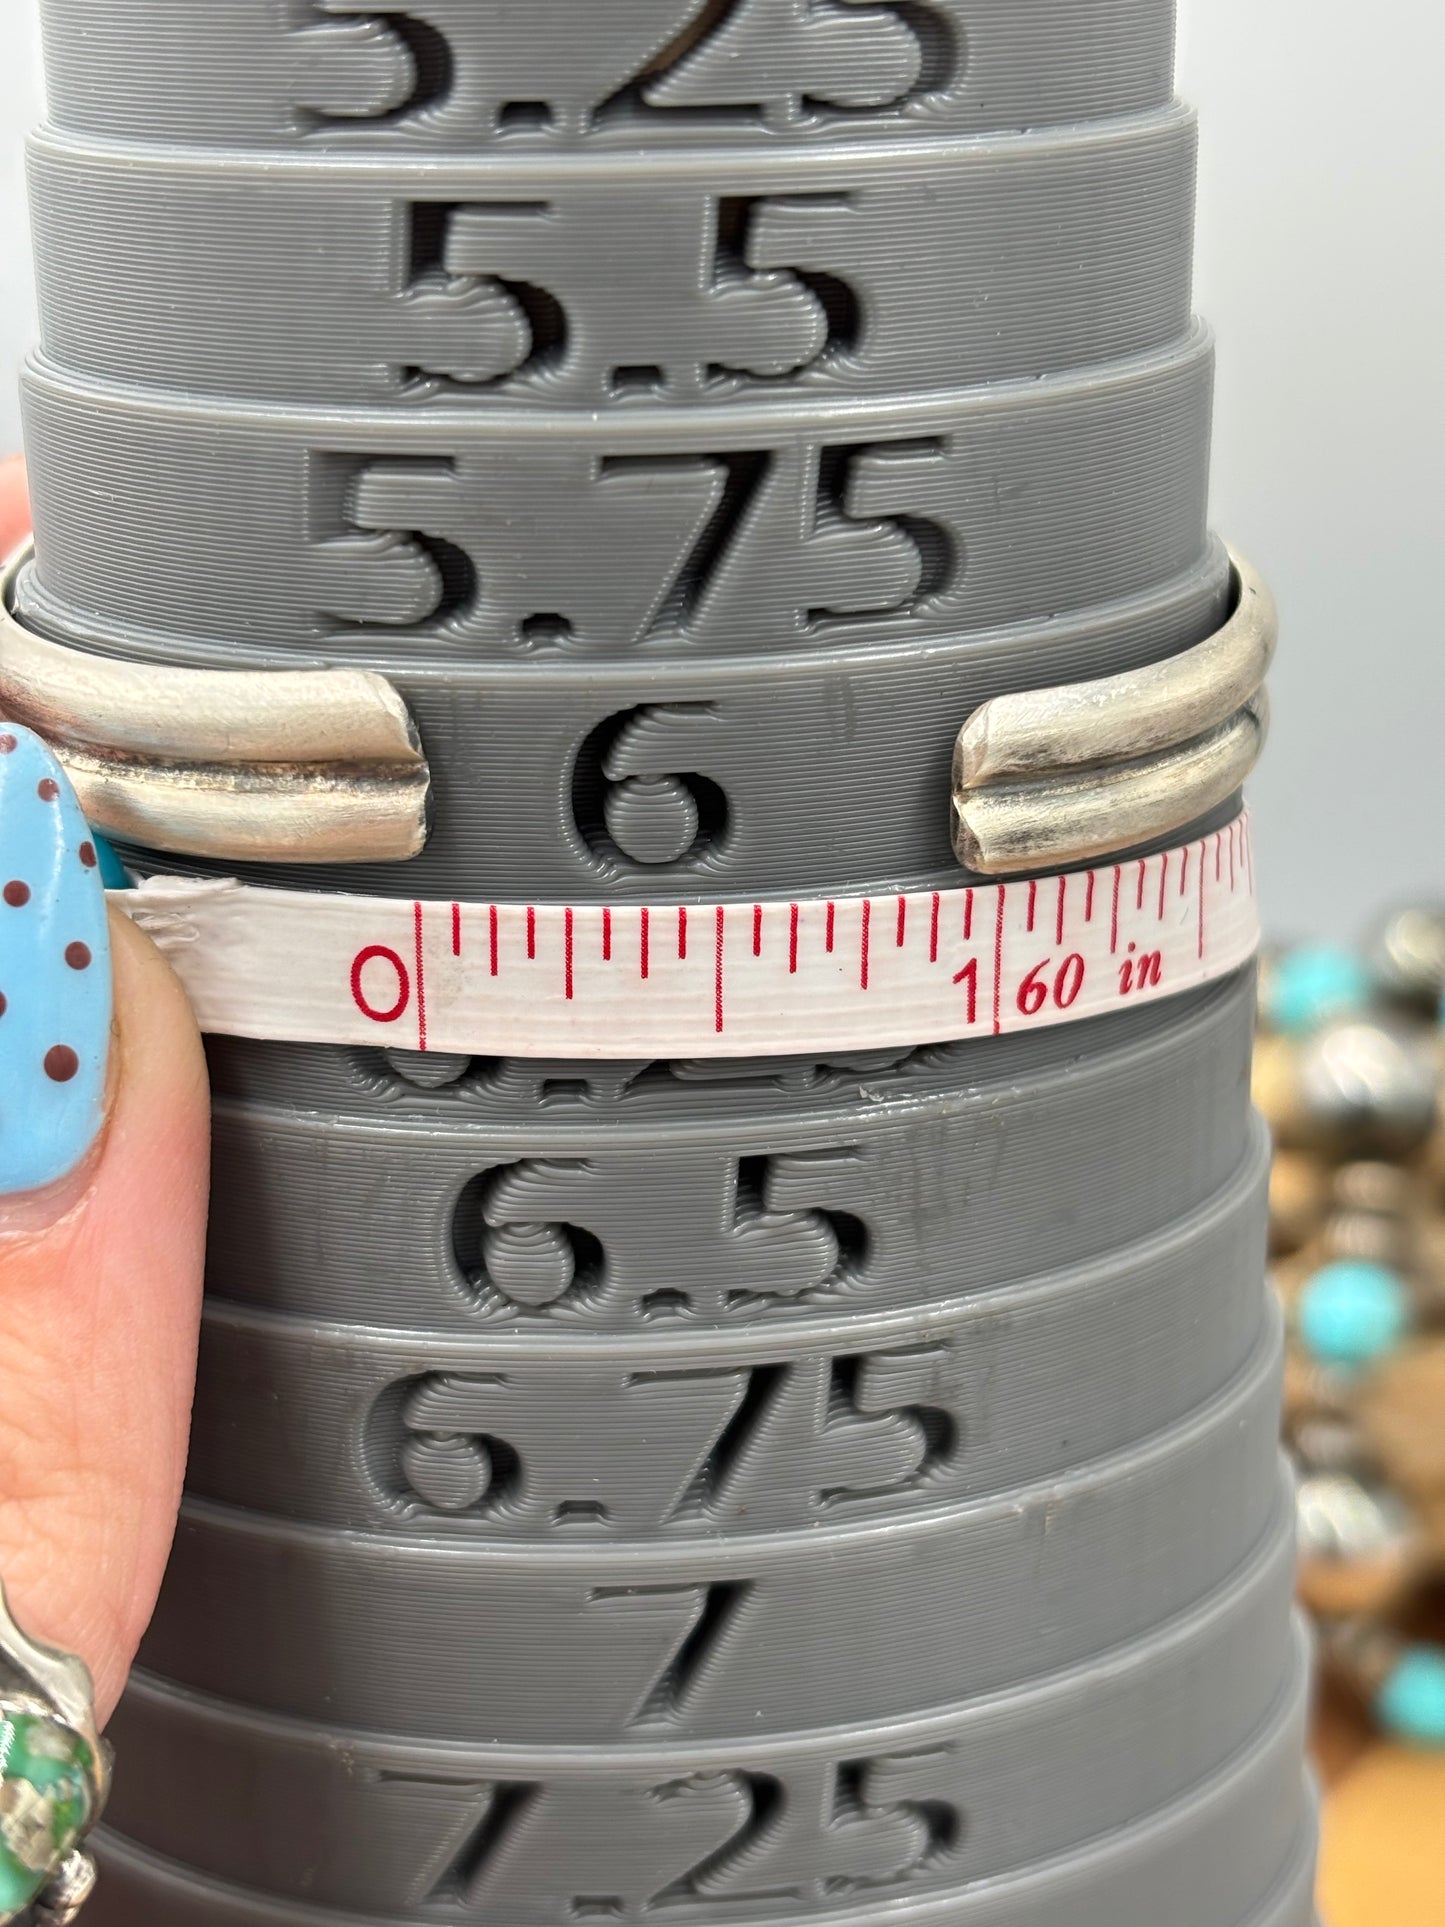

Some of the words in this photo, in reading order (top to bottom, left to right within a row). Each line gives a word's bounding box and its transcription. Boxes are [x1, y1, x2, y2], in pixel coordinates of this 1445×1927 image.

[285, 0, 966, 138] 5.25
[385, 192, 876, 402] 5.5
[304, 436, 966, 648] 5.75
[560, 700, 736, 880] 6
[952, 958, 977, 1025] 1
[1015, 952, 1085, 1016] 60
[1118, 942, 1162, 995] in
[440, 1145, 872, 1323] 6.5
[353, 1342, 959, 1526] 6.75
[585, 1577, 756, 1728] 7
[371, 1744, 964, 1918] 7.25
